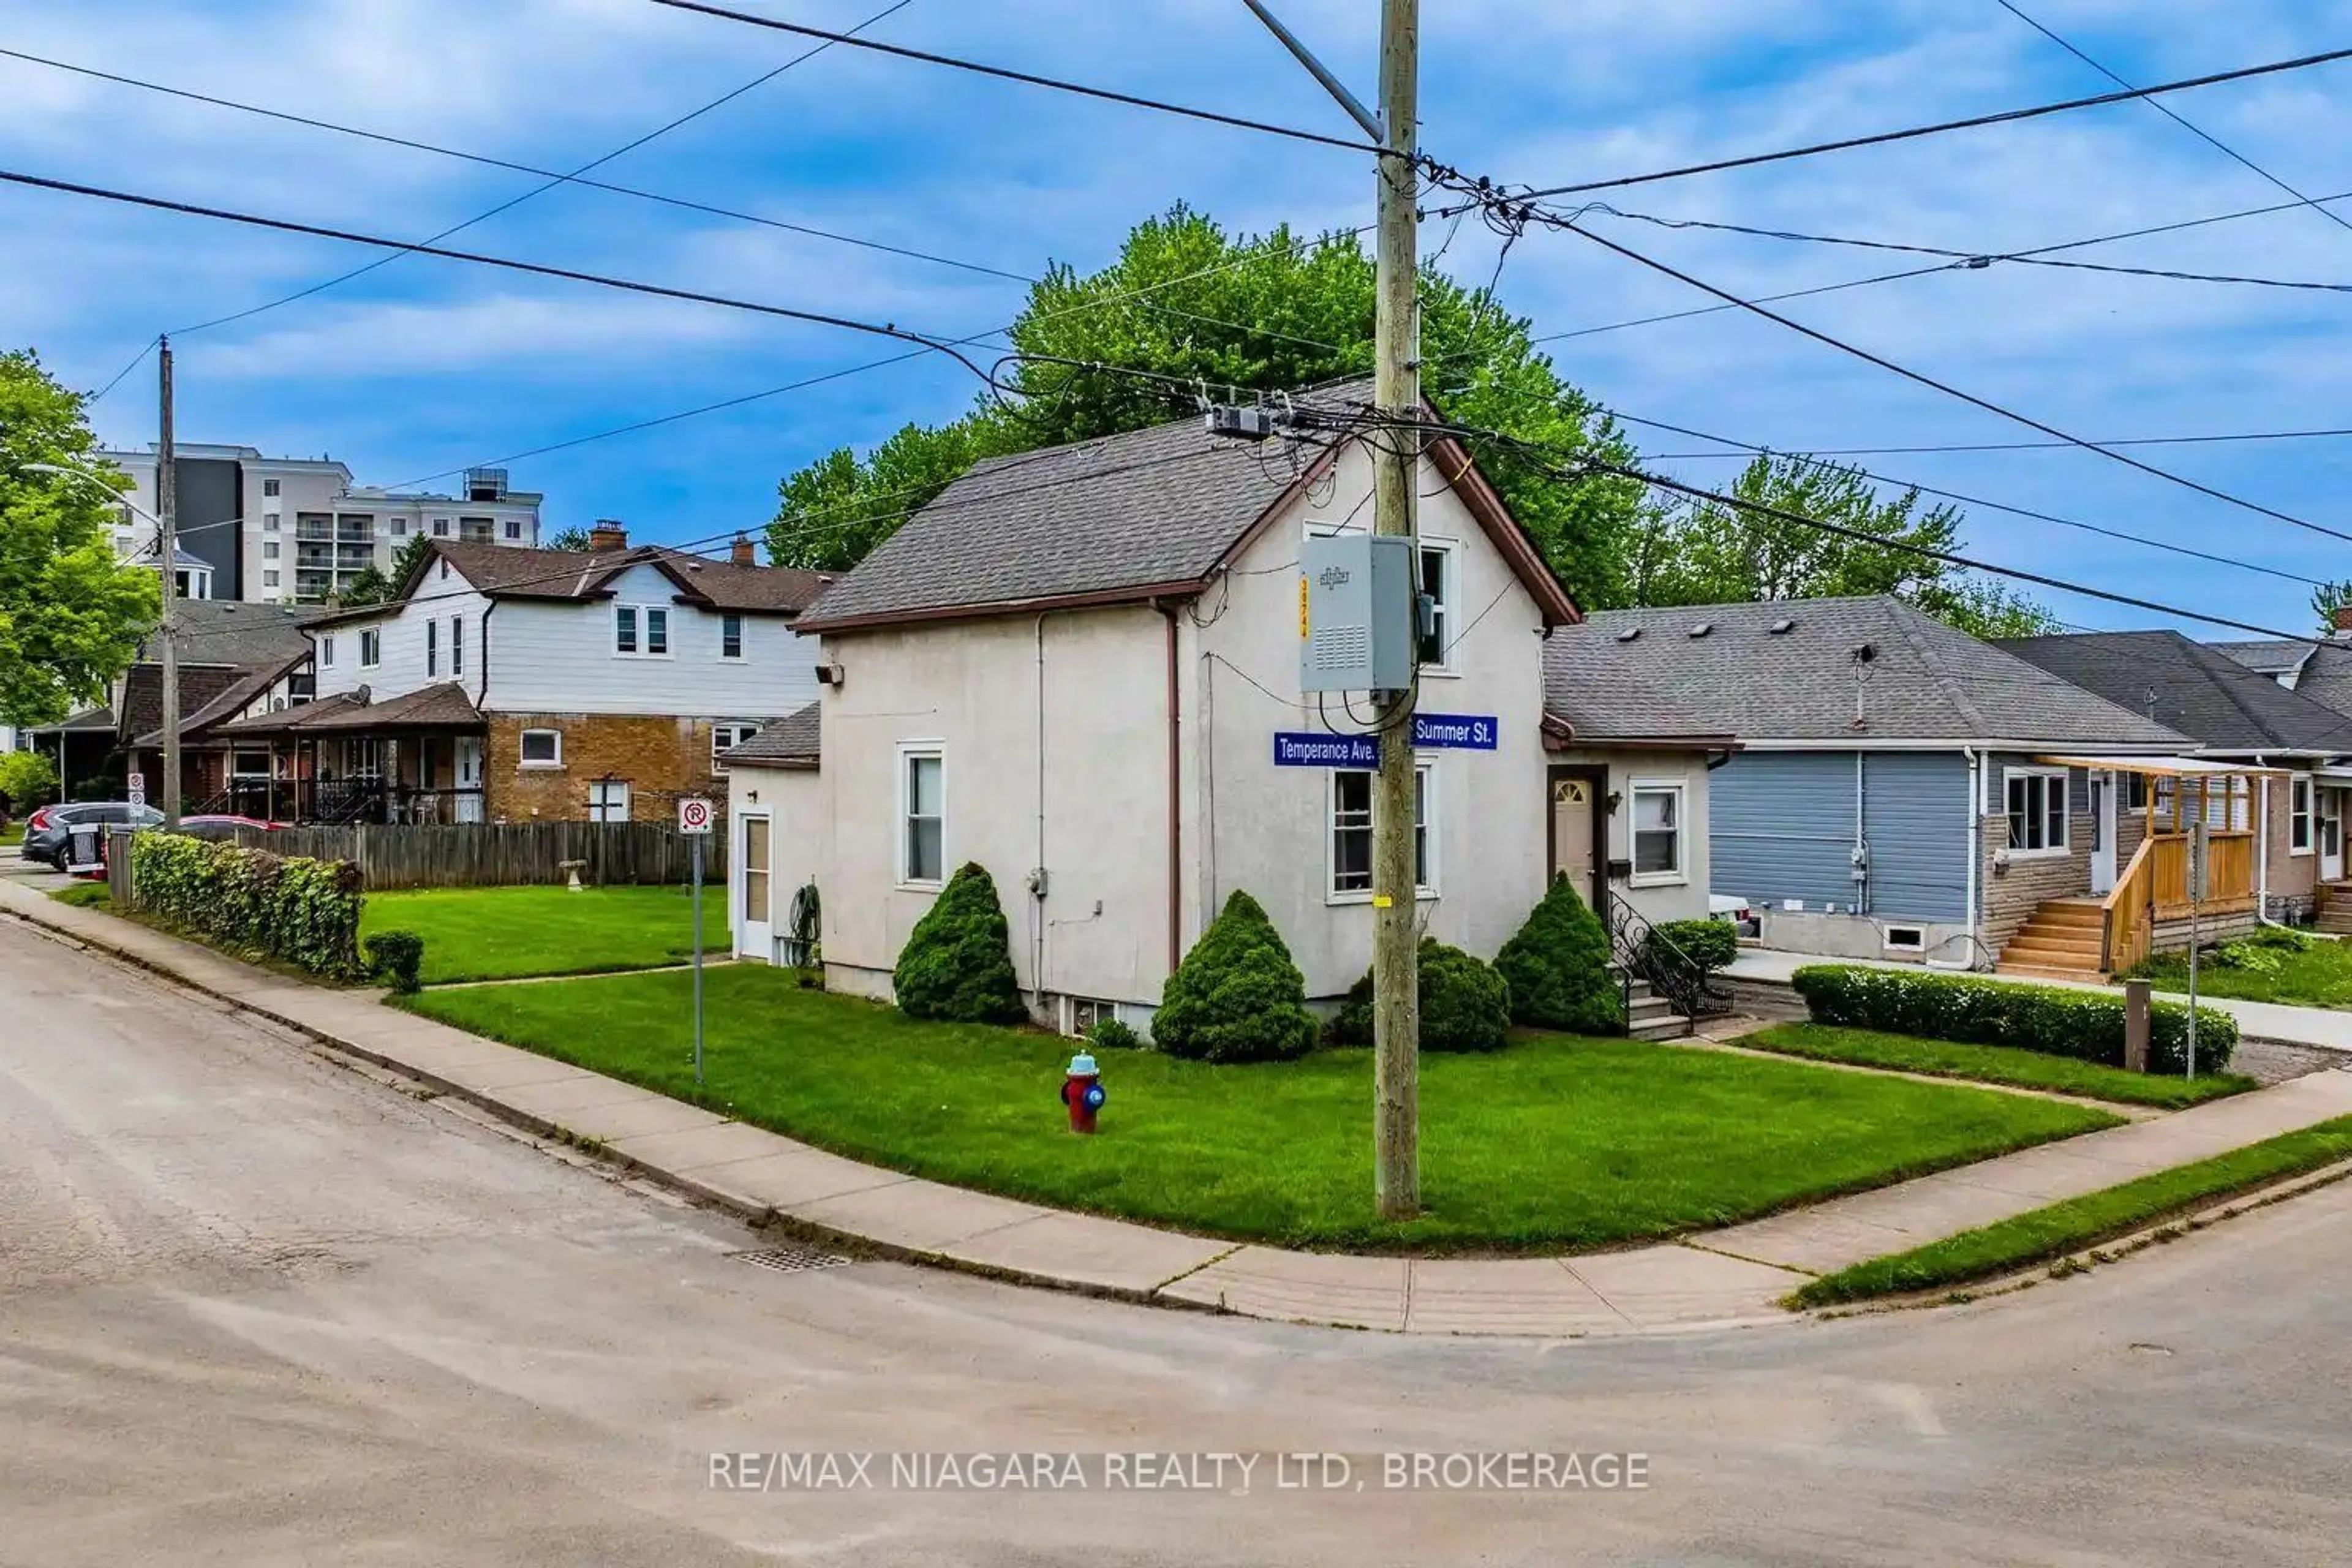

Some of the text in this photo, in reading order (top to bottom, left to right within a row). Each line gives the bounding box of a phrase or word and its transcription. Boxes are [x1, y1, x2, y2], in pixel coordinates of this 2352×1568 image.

[1416, 719, 1491, 742] Summer St.
[1280, 738, 1374, 764] Temperance Ave.
